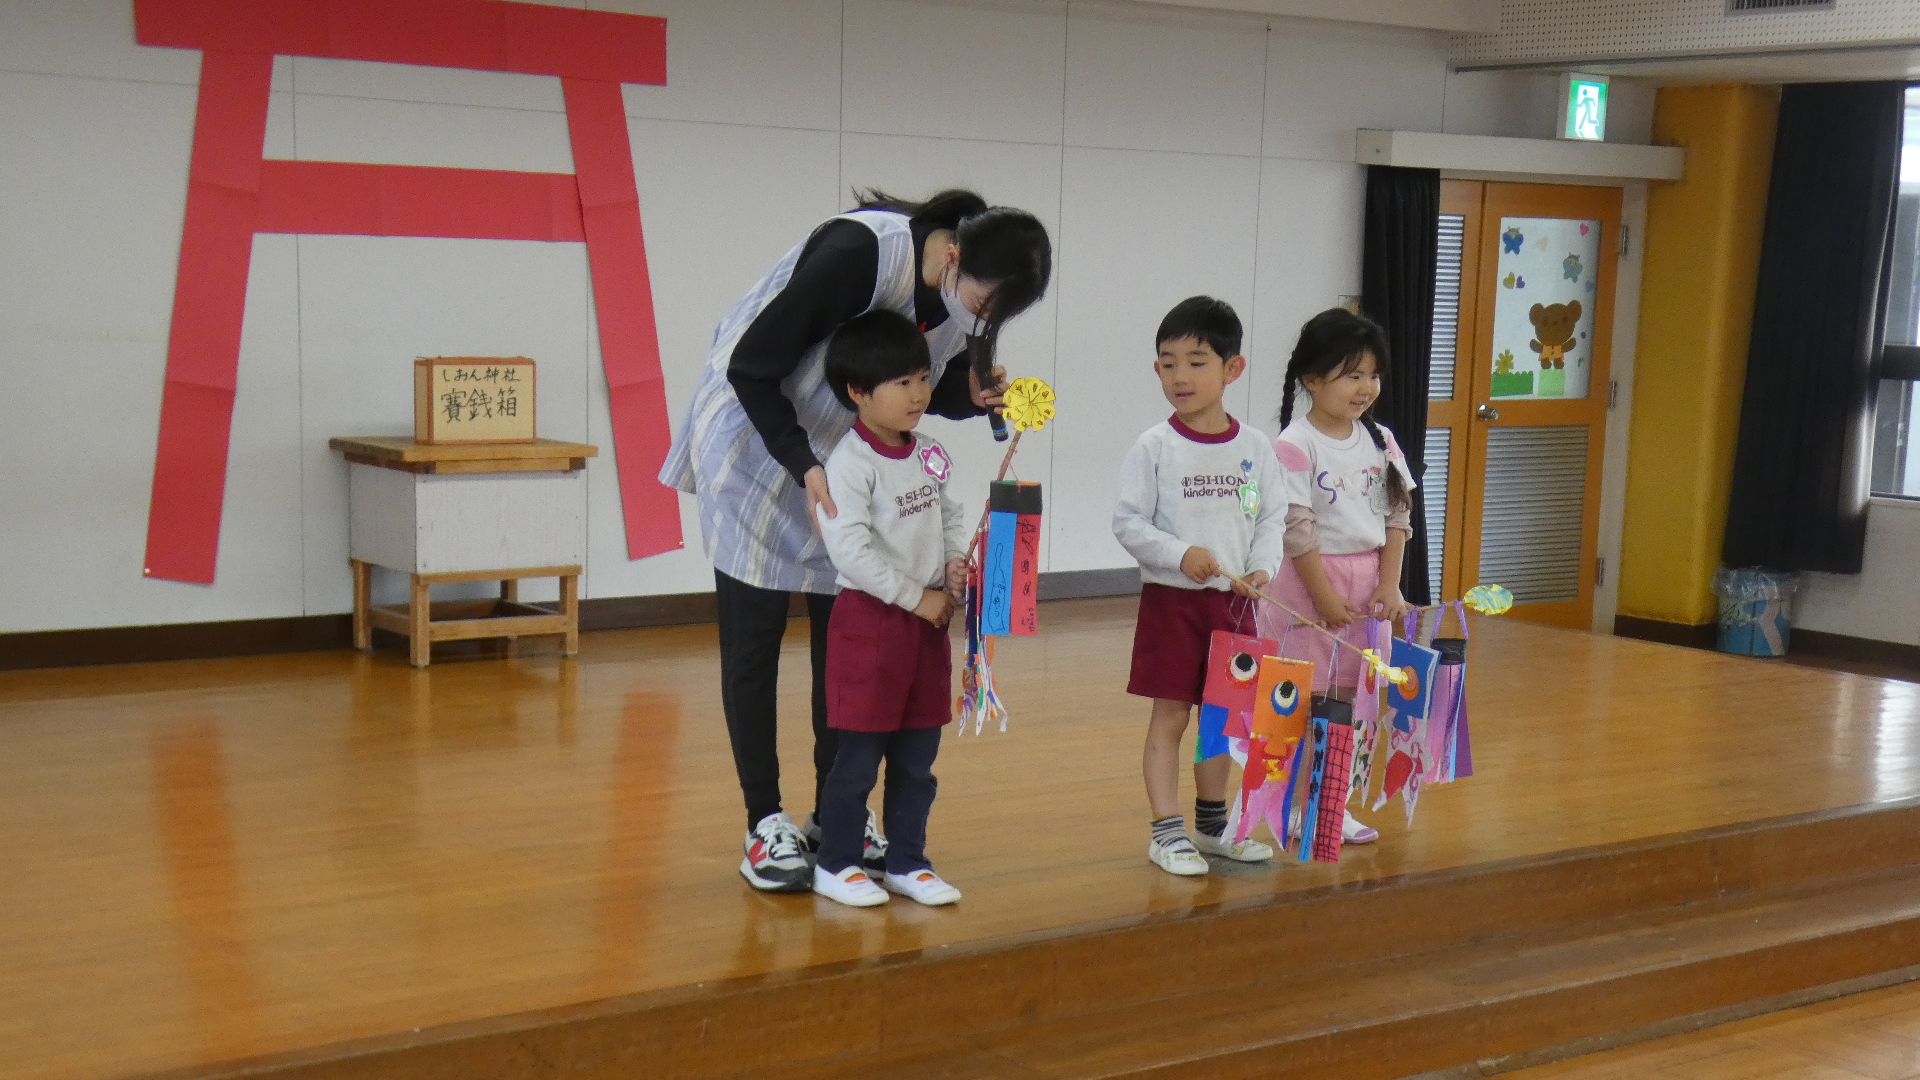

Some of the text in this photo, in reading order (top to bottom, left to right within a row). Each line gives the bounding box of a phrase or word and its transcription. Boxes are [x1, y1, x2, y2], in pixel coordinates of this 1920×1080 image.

[443, 367, 521, 384] しおん神社
[441, 386, 517, 424] 賽銭箱
